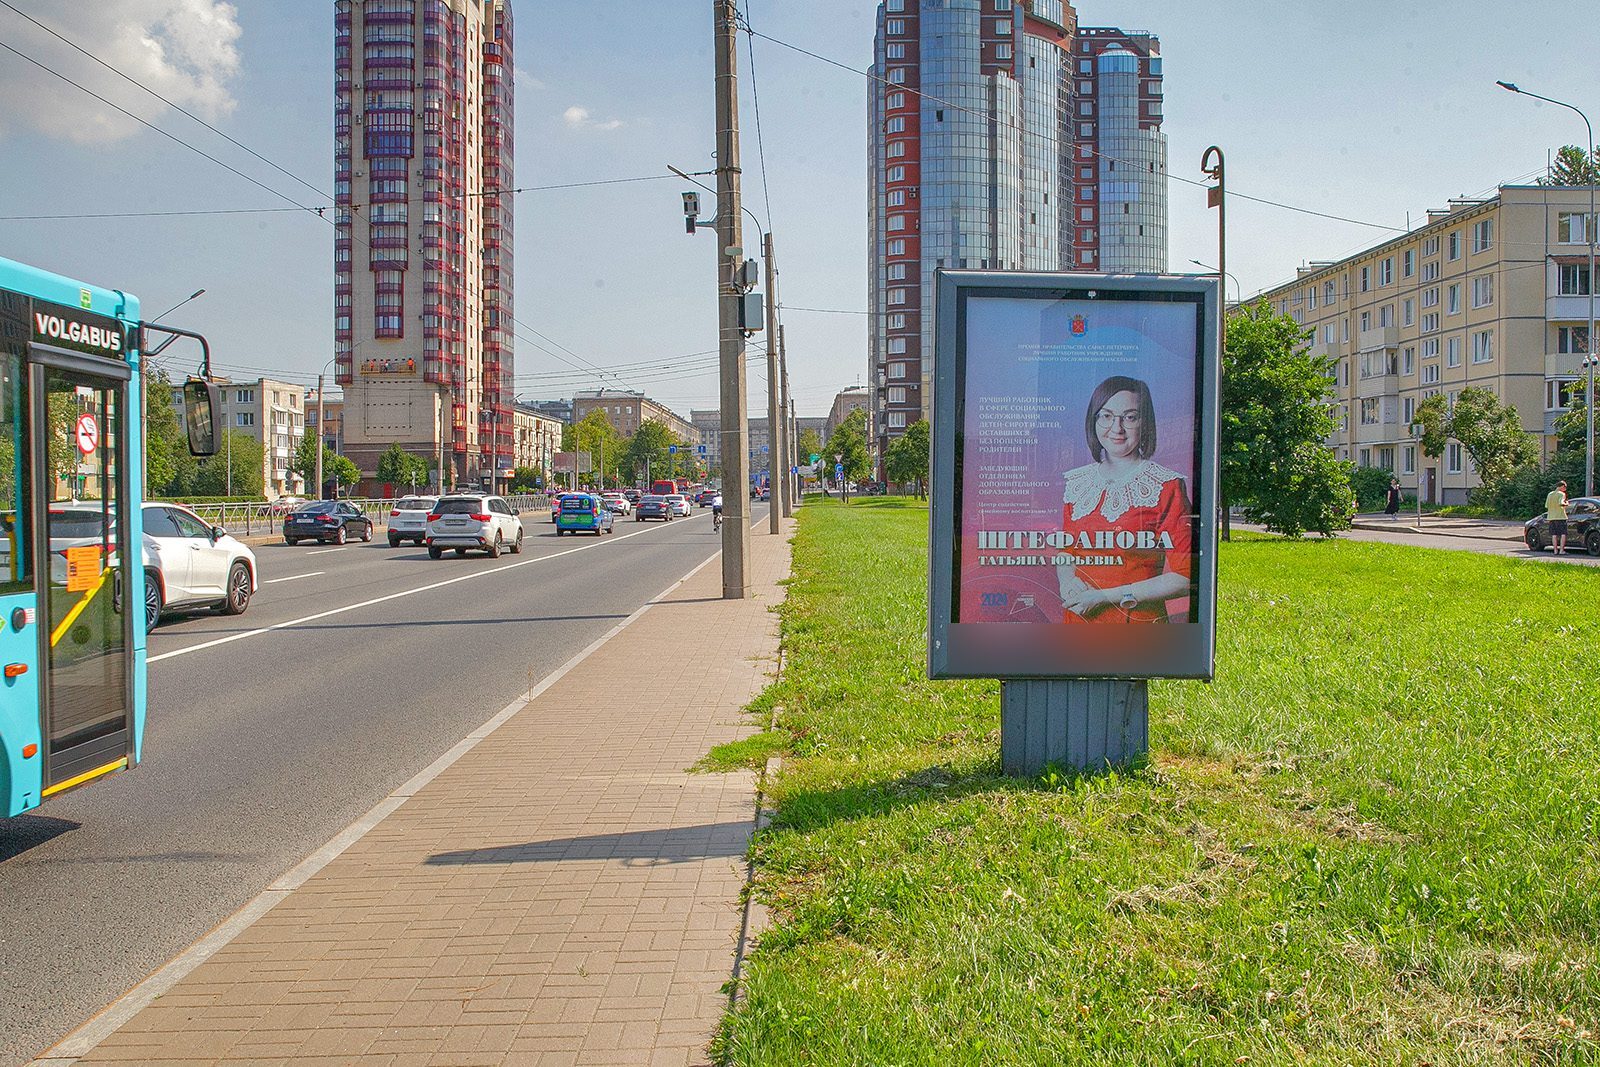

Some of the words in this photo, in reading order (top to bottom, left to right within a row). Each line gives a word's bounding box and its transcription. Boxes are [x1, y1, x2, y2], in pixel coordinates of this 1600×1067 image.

[35, 312, 121, 351] VOLGABUS
[1037, 421, 1062, 429] ДЕТЕЙ,
[977, 530, 1174, 549] ШТЕФАНОВА
[978, 555, 1046, 566] ТАТЬЯНА
[1051, 555, 1123, 566] ЮРЬЕВНА
